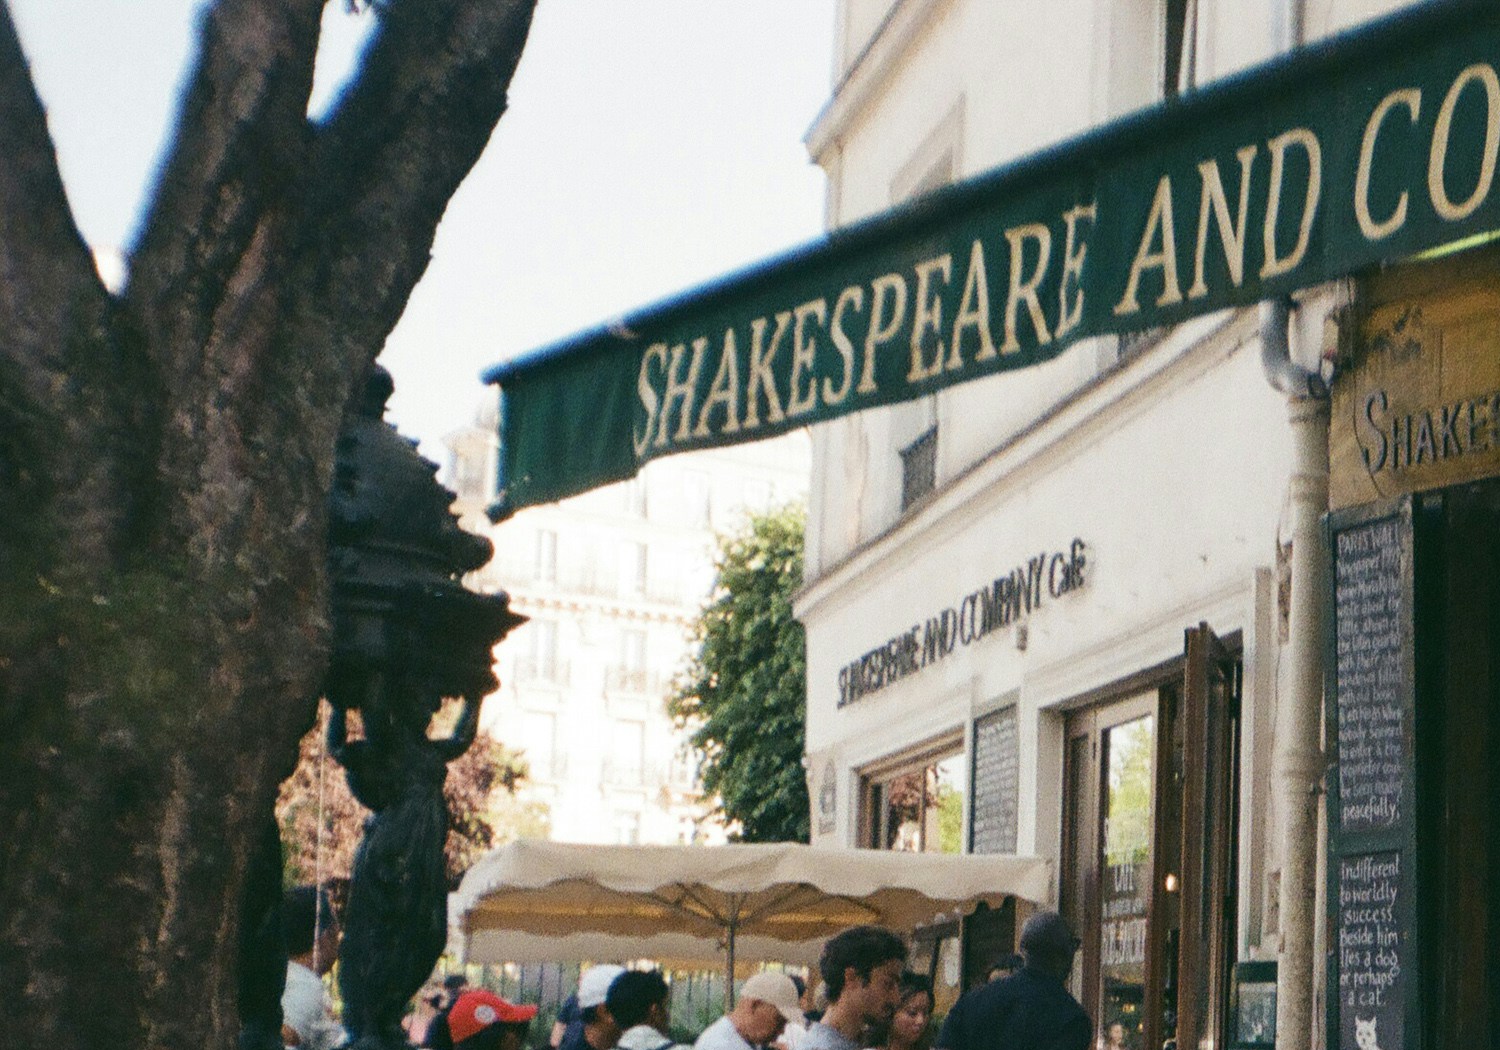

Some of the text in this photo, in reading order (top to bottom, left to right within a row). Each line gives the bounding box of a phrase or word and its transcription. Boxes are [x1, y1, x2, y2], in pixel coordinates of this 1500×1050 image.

[632, 199, 1099, 457] SHAKESPEARE
[1113, 127, 1323, 315] AND
[1338, 531, 1369, 554] PARIS
[920, 607, 958, 669] AND
[959, 551, 1046, 647] COMPANY
[1340, 881, 1398, 908] to worldly
[1339, 924, 1398, 946] Beside him
[1340, 947, 1401, 978] lies a dog
[1340, 967, 1394, 991] or perhaps
[1348, 990, 1355, 1006] a
